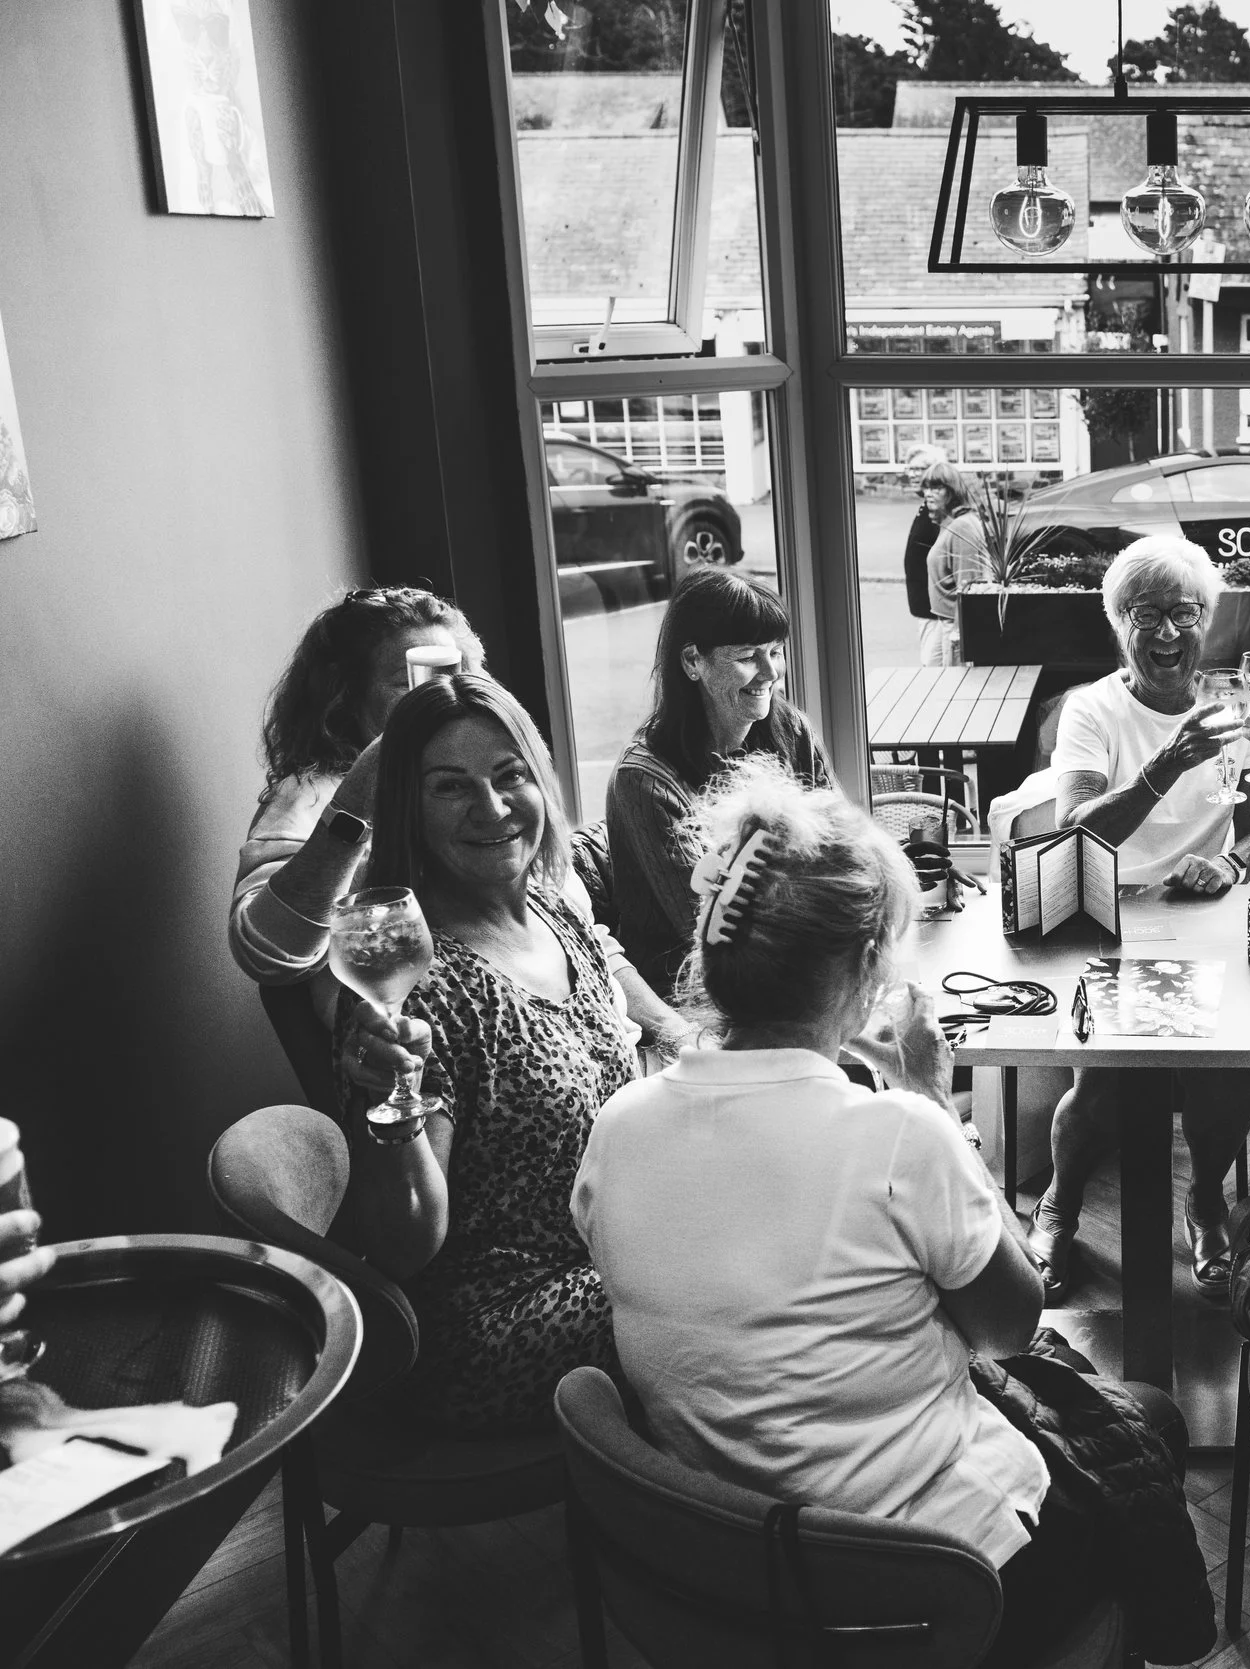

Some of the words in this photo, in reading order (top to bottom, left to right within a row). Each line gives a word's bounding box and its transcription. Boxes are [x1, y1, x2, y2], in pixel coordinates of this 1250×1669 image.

[859, 324, 925, 339] Independent
[926, 324, 957, 337] Estate
[958, 324, 995, 339] Agents
